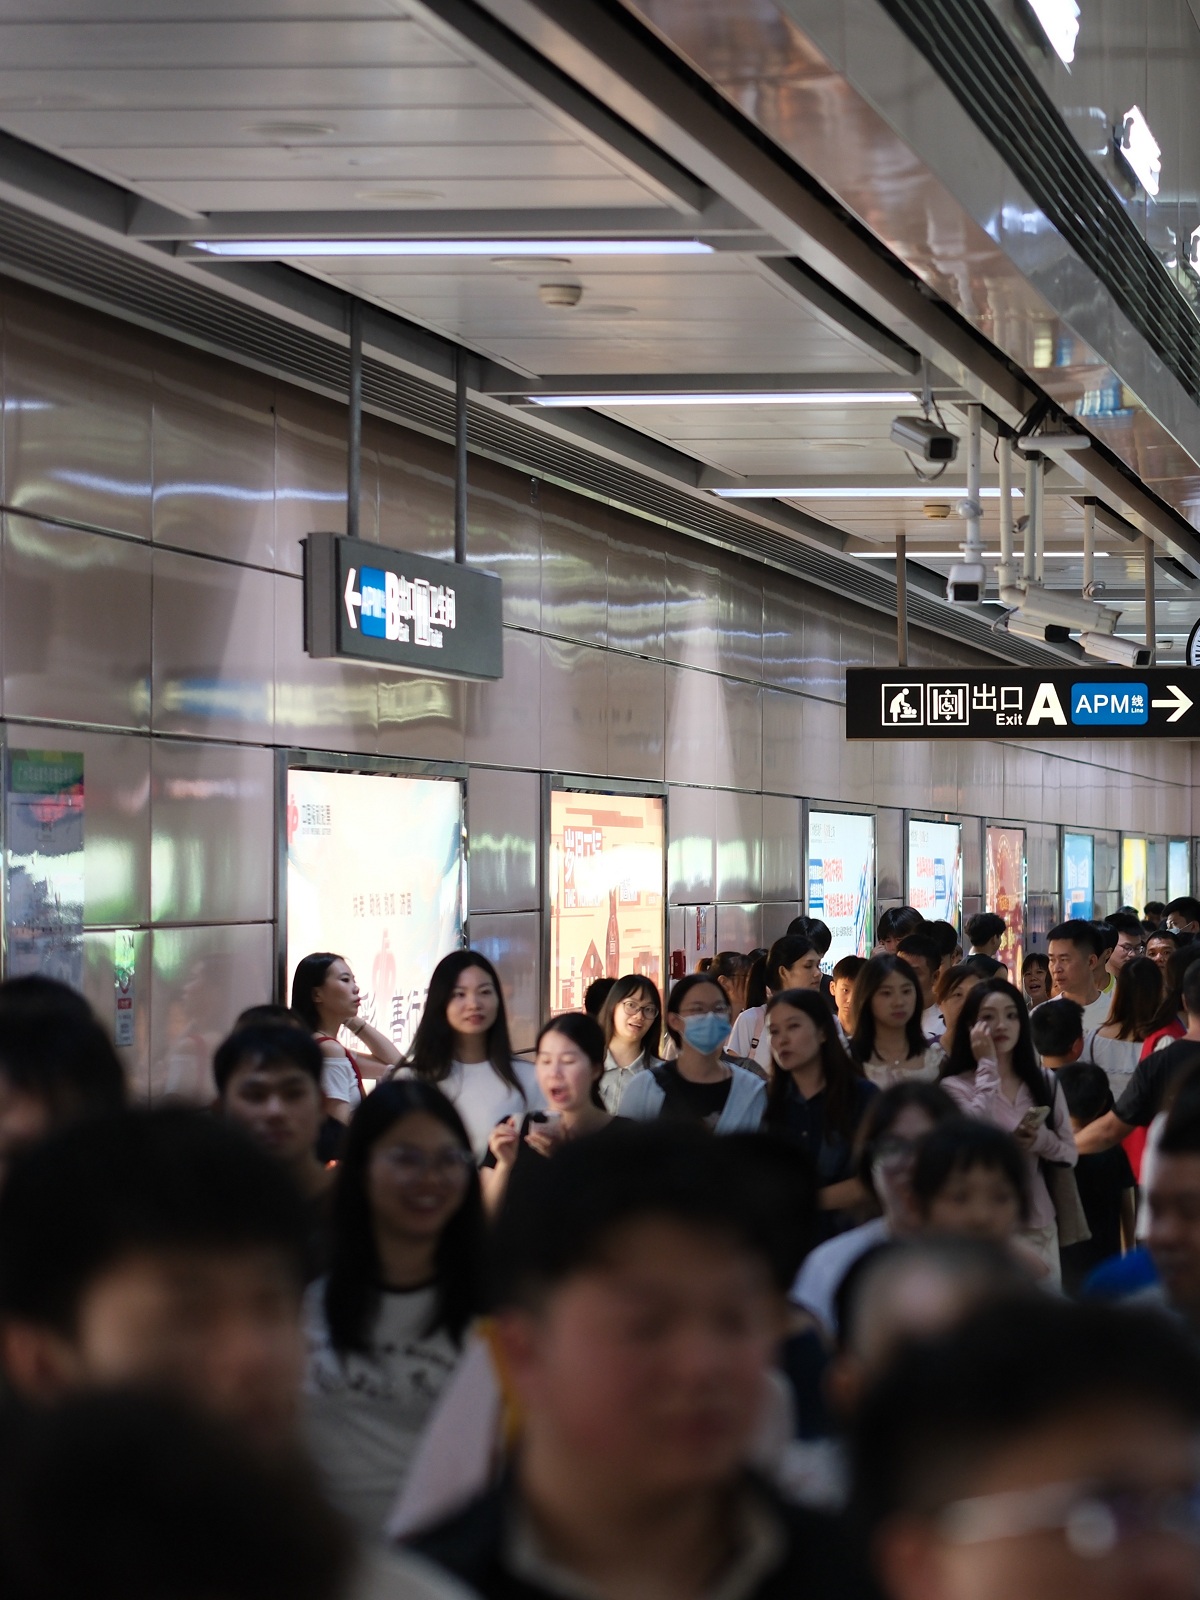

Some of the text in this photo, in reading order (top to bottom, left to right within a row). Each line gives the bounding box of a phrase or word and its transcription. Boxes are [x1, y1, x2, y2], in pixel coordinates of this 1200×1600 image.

[386, 571, 399, 640] B
[972, 683, 1023, 712] 出口
[1026, 682, 1068, 726] A
[996, 712, 1023, 726] Exit
